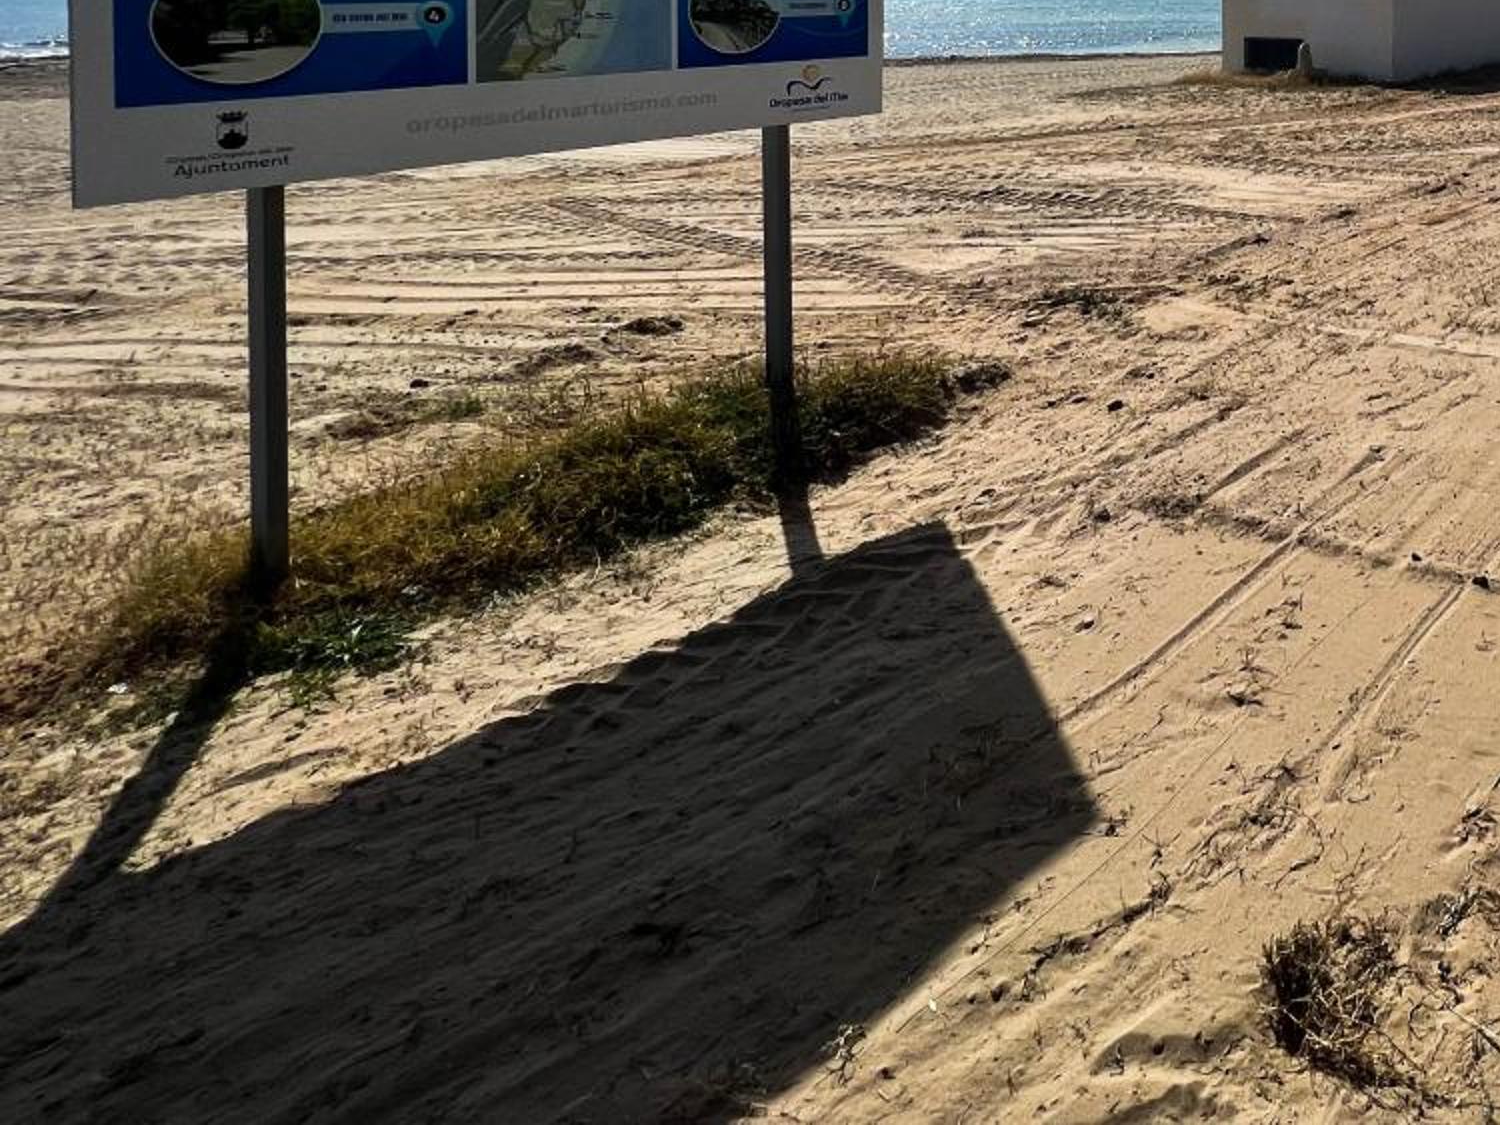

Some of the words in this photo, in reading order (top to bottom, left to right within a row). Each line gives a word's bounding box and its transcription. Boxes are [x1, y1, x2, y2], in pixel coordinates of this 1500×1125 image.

[428, 10, 440, 22] 4
[405, 92, 718, 134] oropesadelmarturismo.com
[173, 154, 290, 180] Ajuntament
